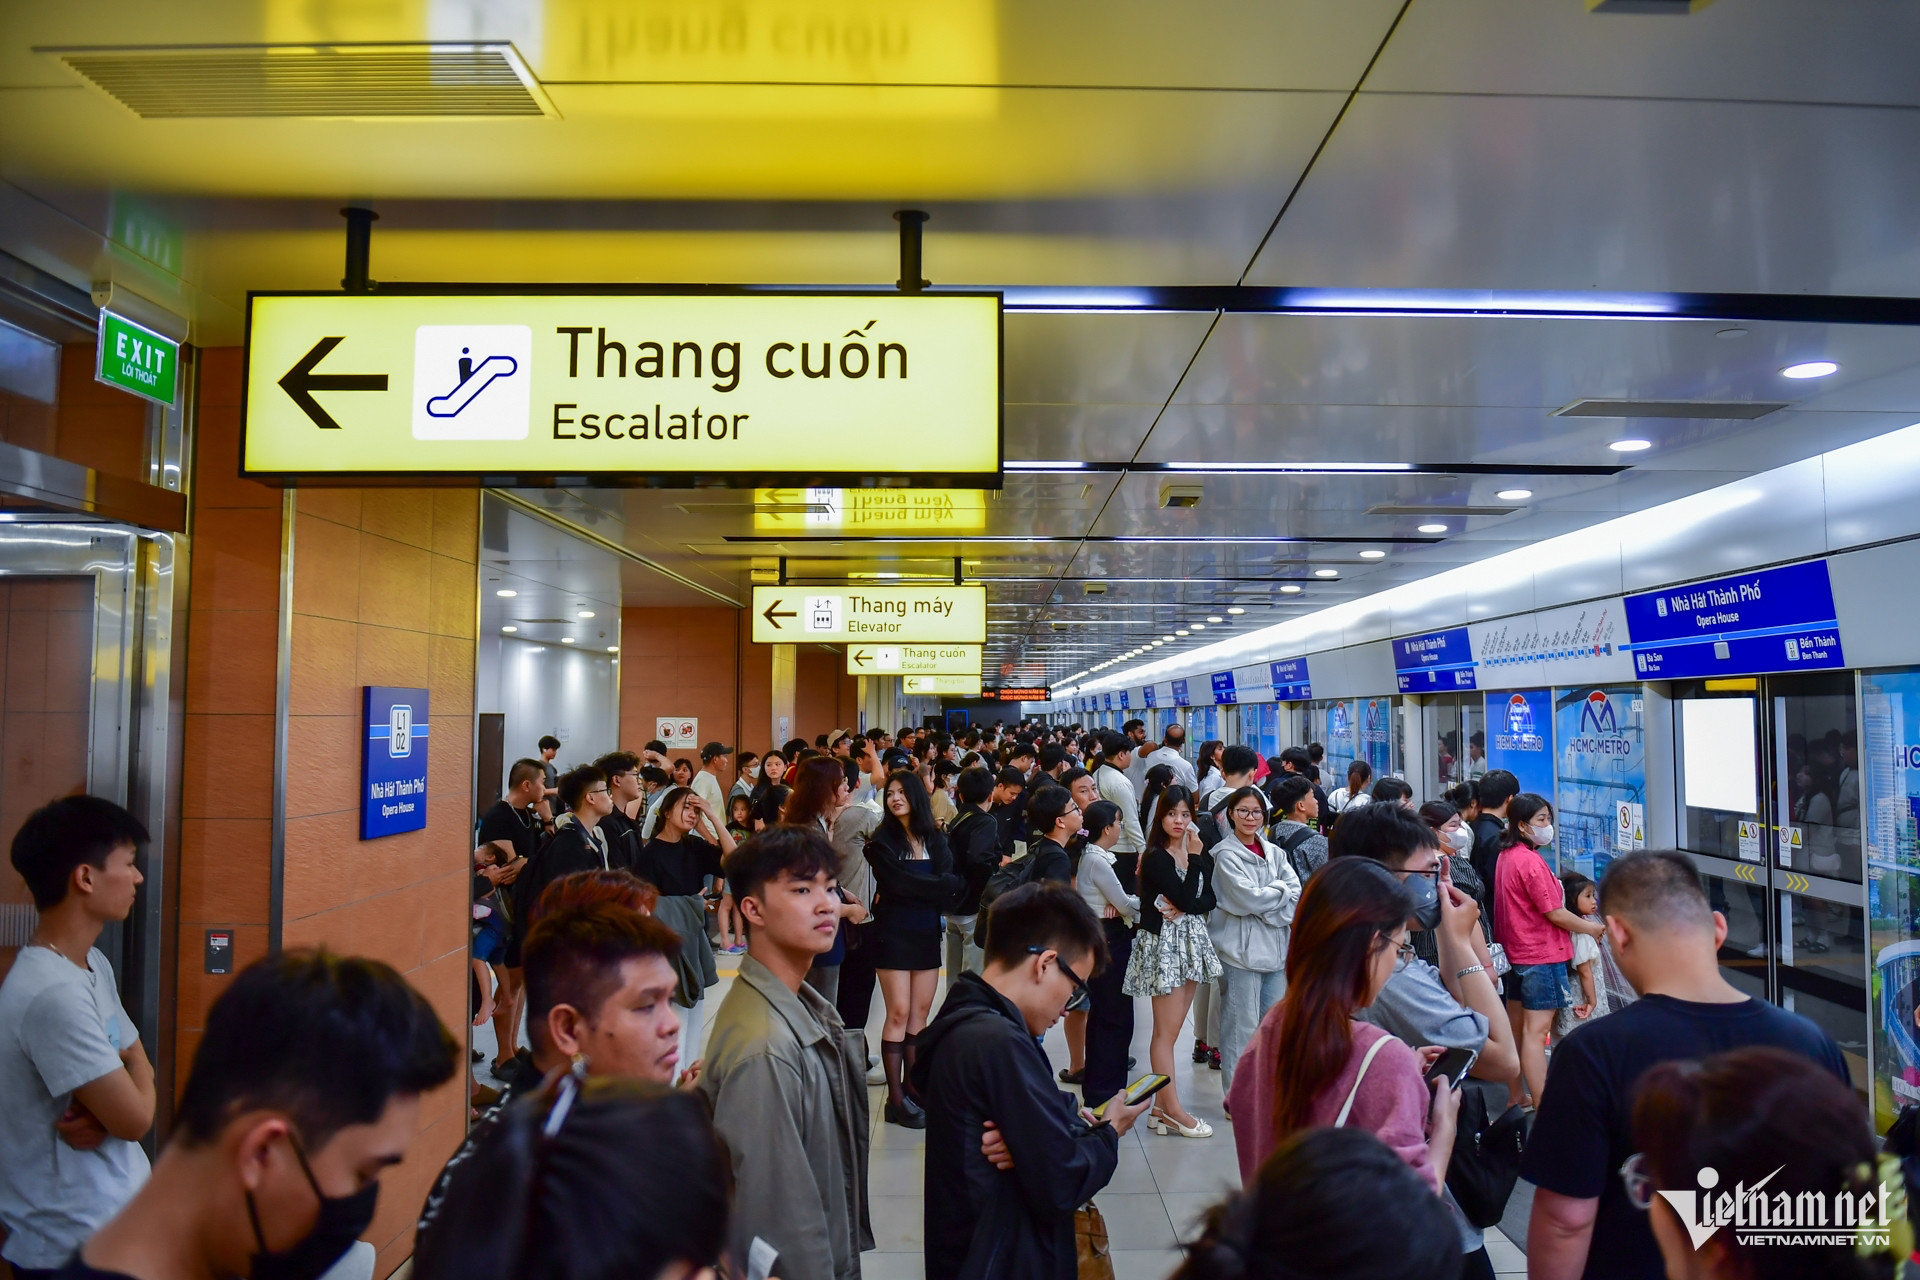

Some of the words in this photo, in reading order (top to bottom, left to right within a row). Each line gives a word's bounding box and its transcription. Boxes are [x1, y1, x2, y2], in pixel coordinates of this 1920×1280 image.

[116, 331, 165, 374] EXIT
[556, 327, 741, 393] Thang
[765, 319, 908, 379] cuốn
[553, 404, 750, 440] Escalator
[1671, 595, 1690, 612] Nhà
[1690, 592, 1707, 609] Hát
[1707, 587, 1738, 606] Thành
[1739, 579, 1761, 601] Phố
[849, 596, 905, 617] Thang
[914, 596, 954, 617] máy
[848, 621, 902, 632] Elevator
[1696, 615, 1716, 629] Opera
[1717, 612, 1739, 624] House
[1799, 636, 1813, 648] Bến
[1813, 635, 1836, 648] Thành
[903, 648, 936, 659] Thang
[396, 712, 406, 730] L1
[395, 732, 406, 750] 02
[1570, 738, 1595, 754] HCMC
[1597, 739, 1631, 755] METRO
[371, 782, 384, 799] Nhà
[384, 781, 395, 798] Hát
[396, 780, 413, 796] Thành
[413, 776, 425, 794] Phố
[382, 804, 398, 819] Opera
[399, 802, 415, 813] House
